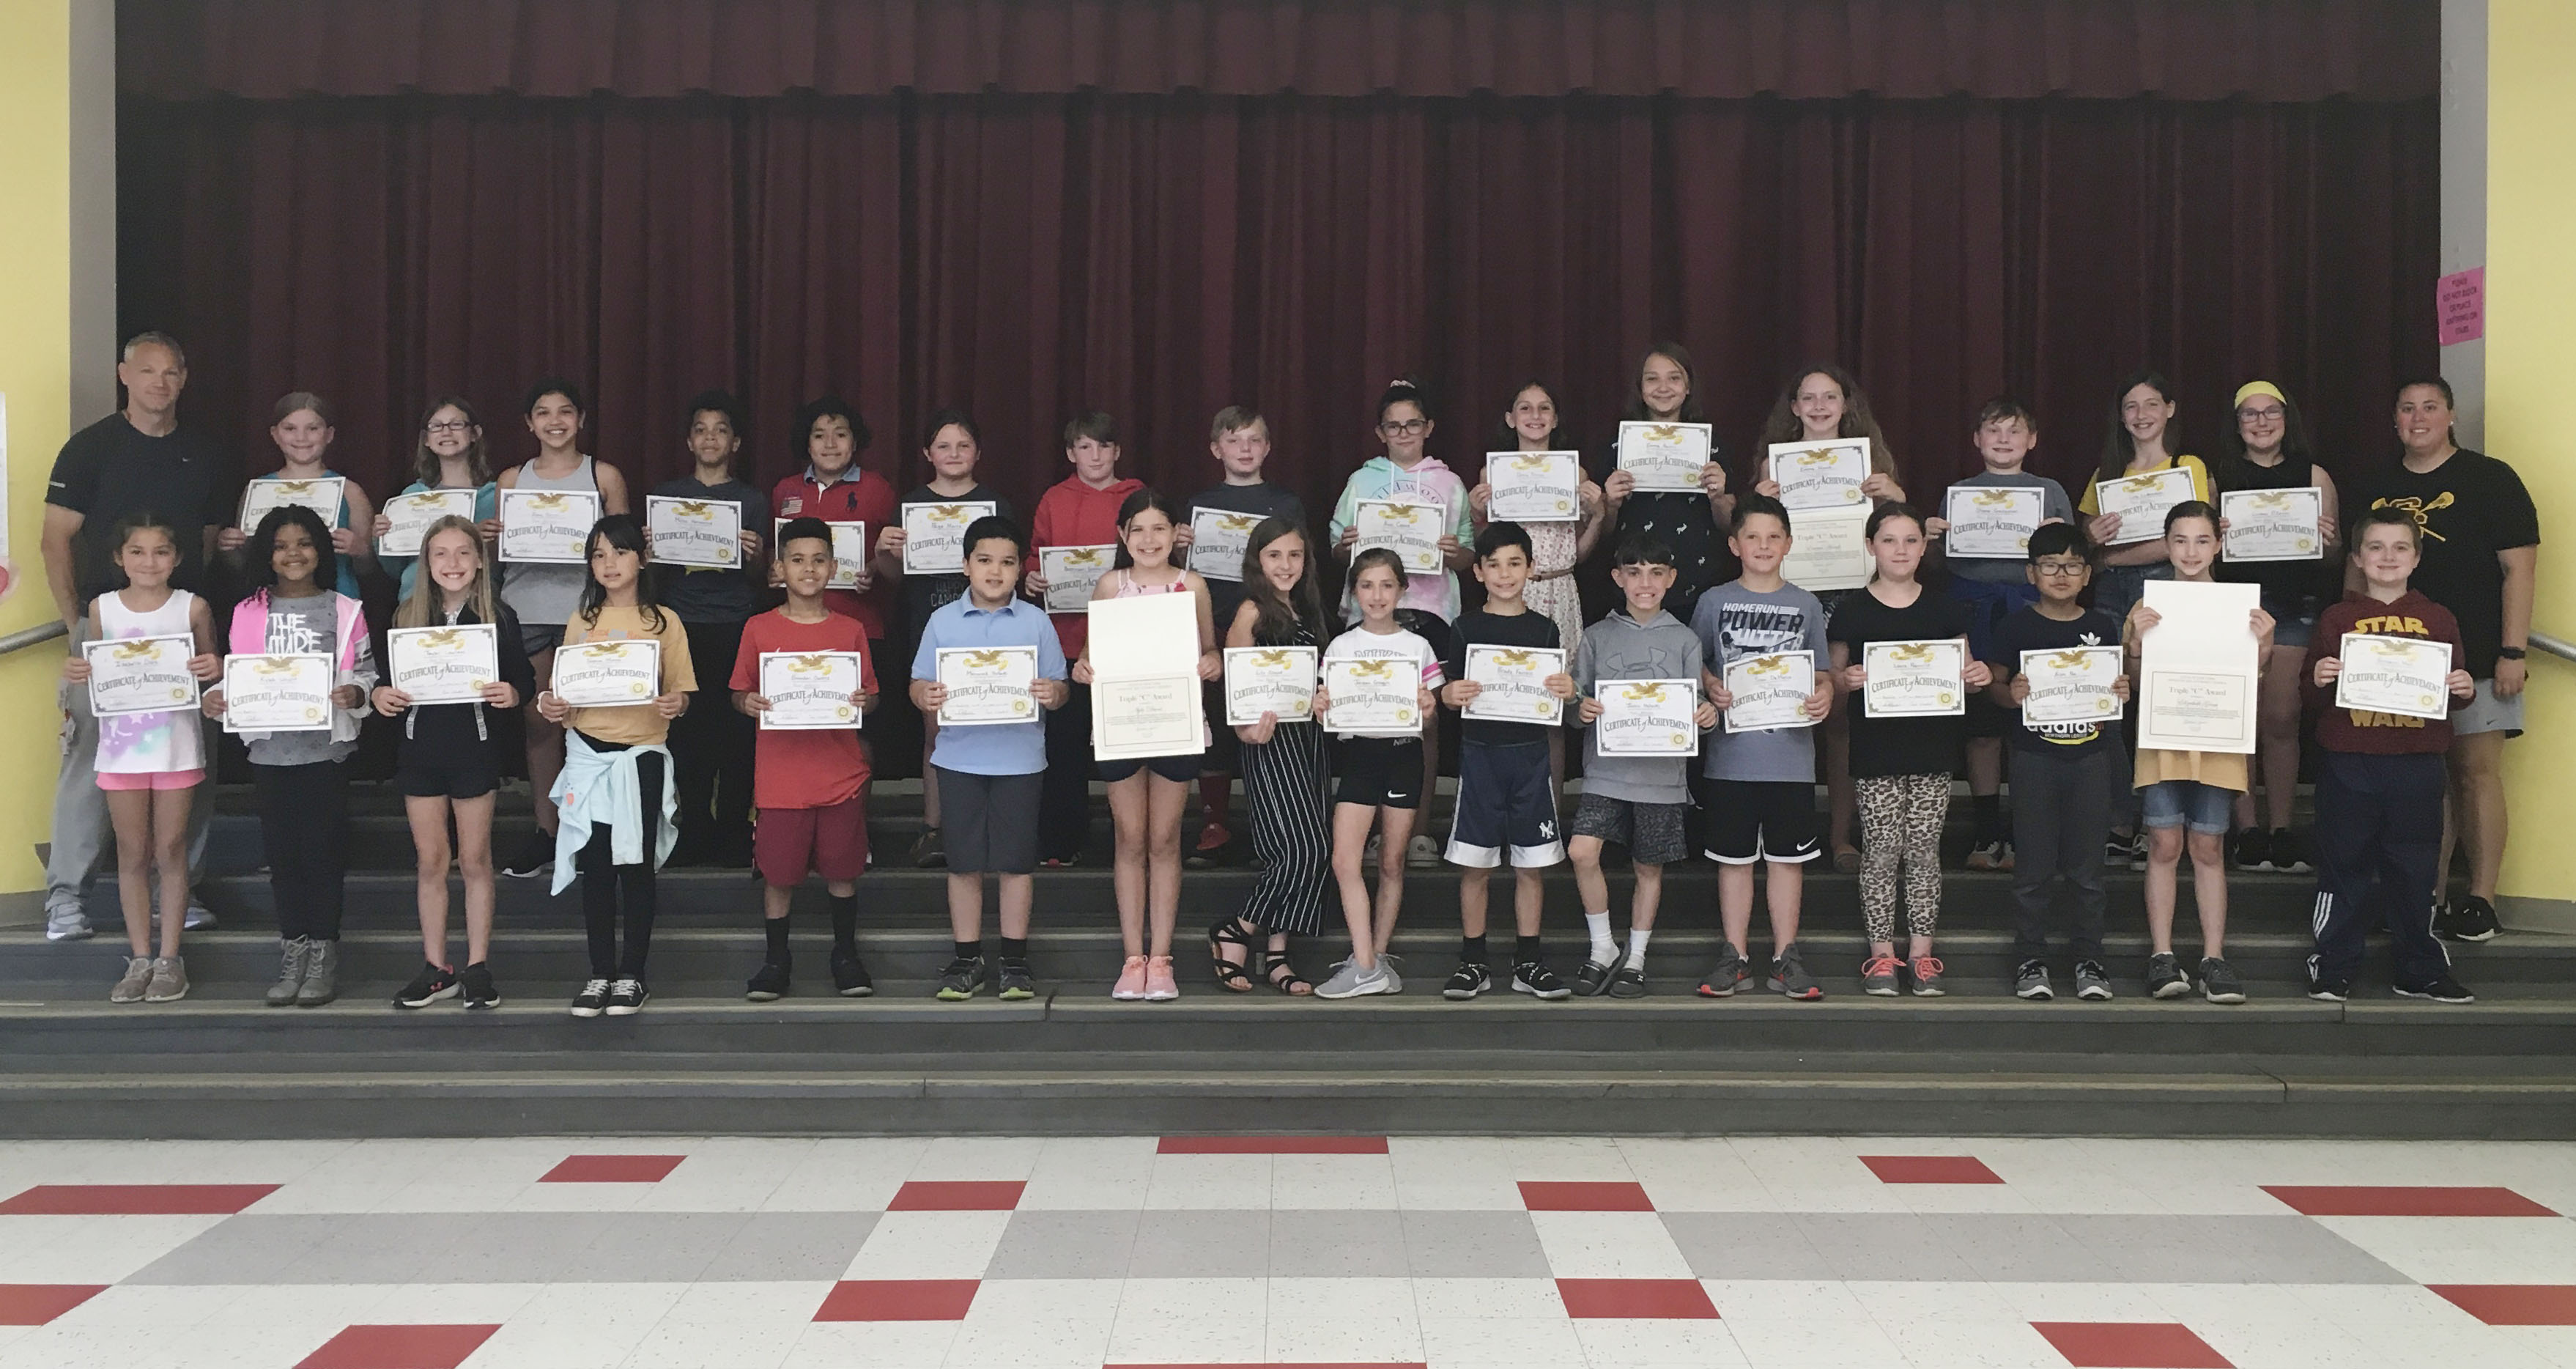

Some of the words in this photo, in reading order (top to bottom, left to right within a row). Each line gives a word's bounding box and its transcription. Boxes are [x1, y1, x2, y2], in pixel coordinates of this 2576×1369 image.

[391, 520, 421, 532] ERTIFICATE
[1722, 602, 1779, 613] HOMERUN
[269, 613, 307, 636] THE
[1718, 610, 1805, 633] POWER
[2347, 616, 2429, 635] STAR
[813, 688, 851, 701] ACHIEVEMEN
